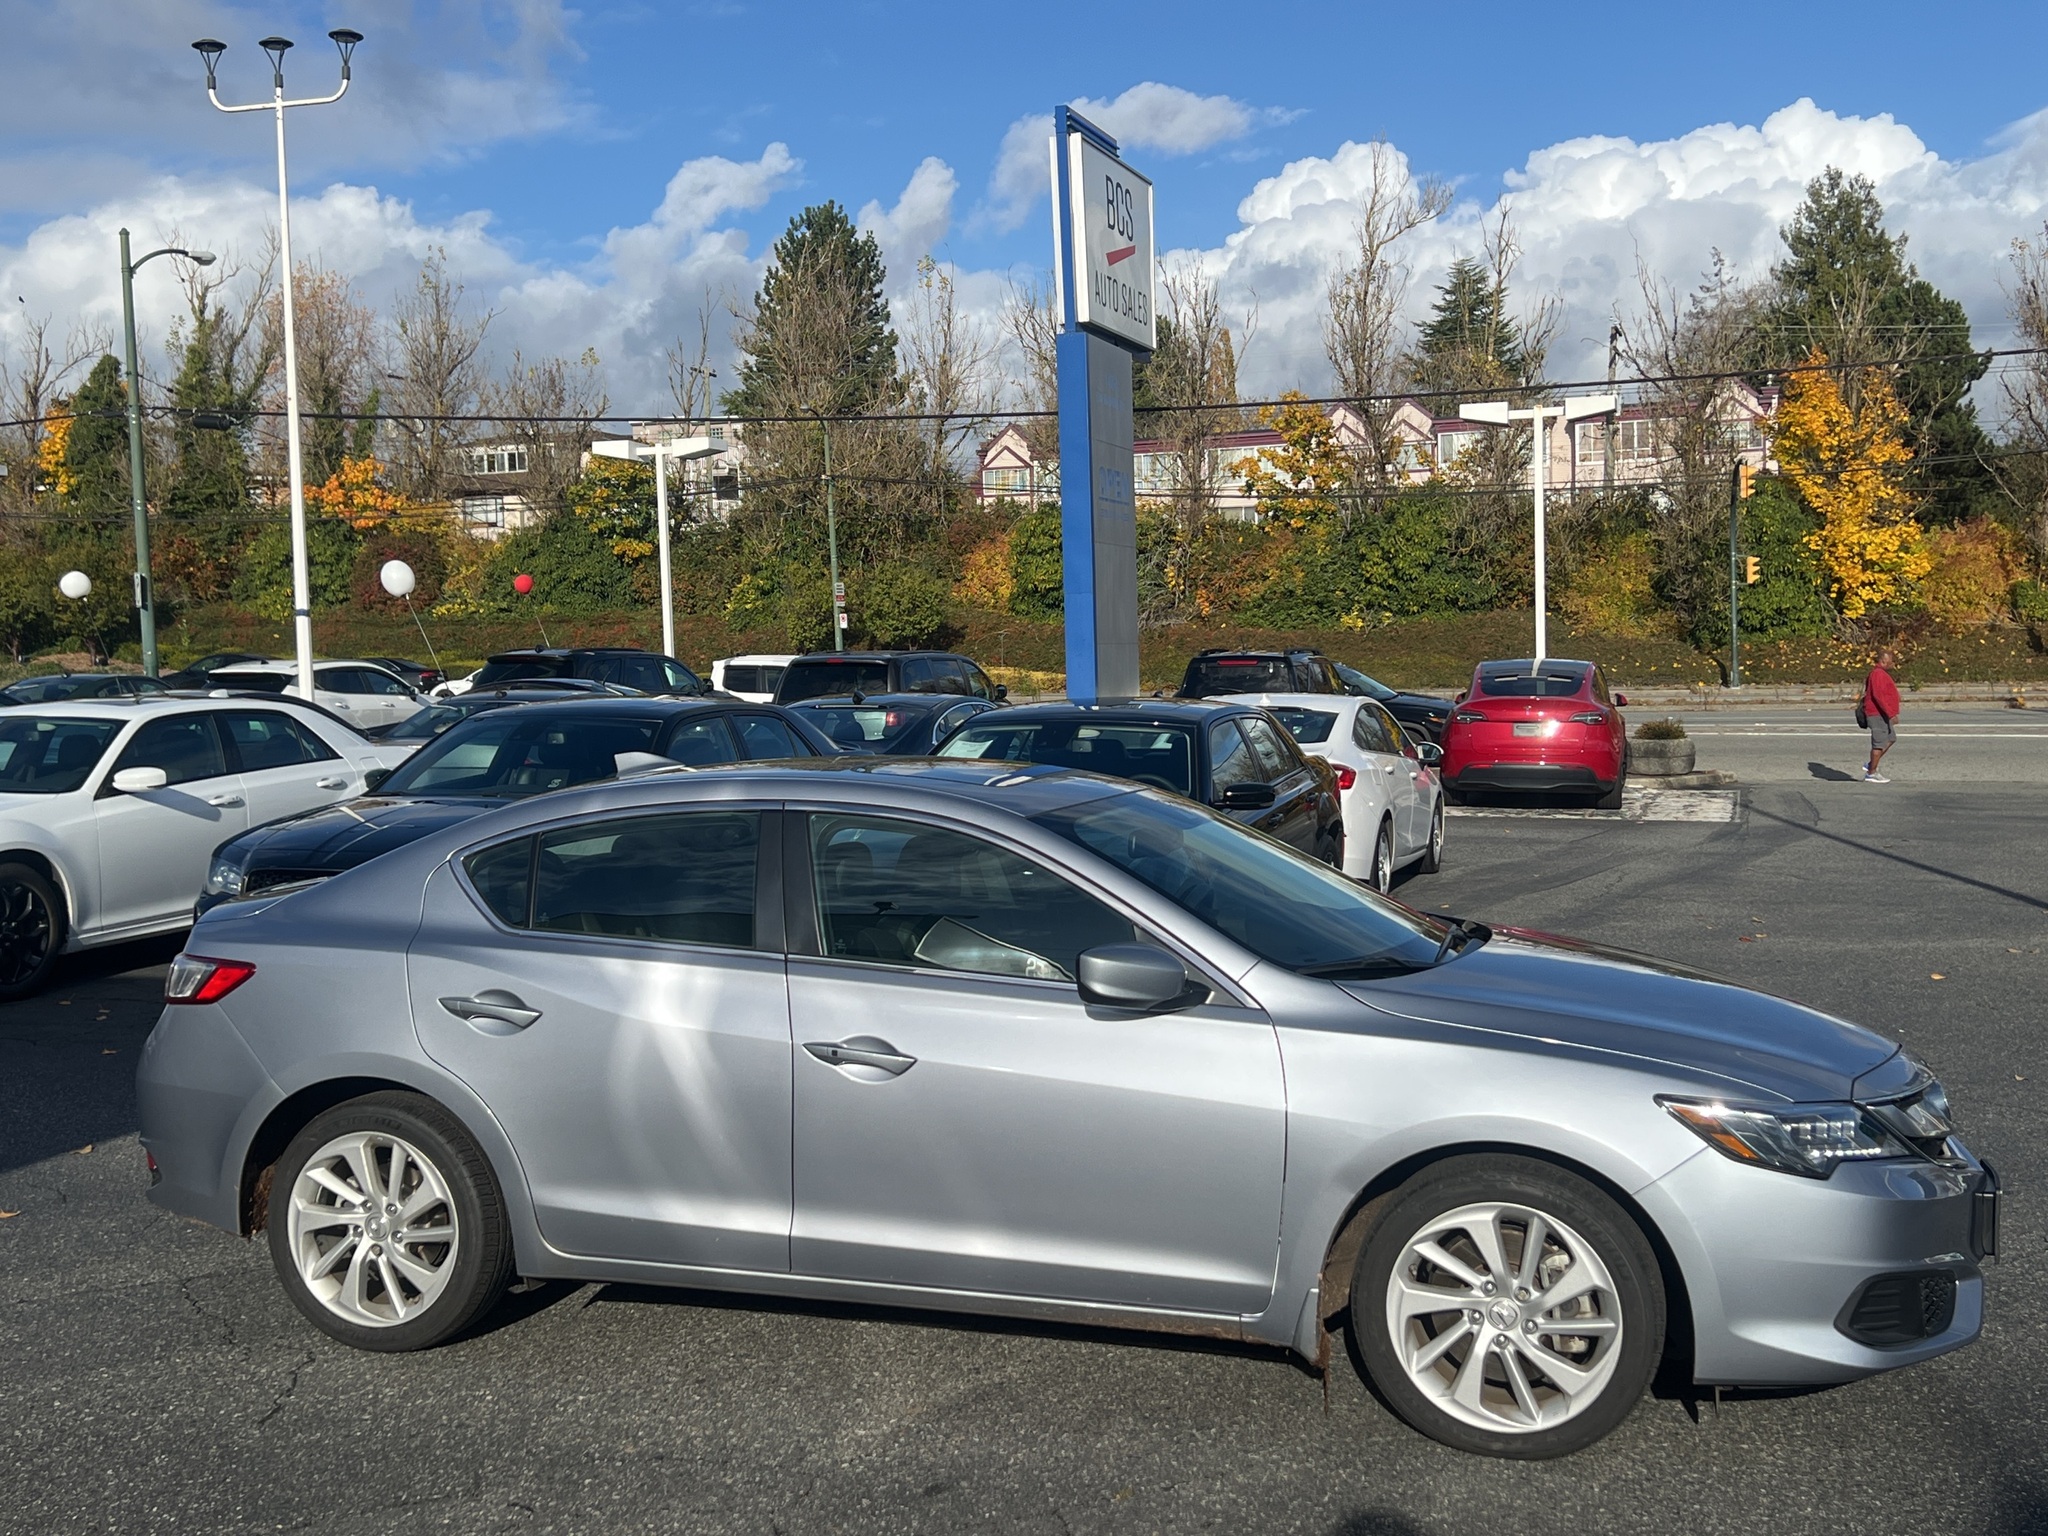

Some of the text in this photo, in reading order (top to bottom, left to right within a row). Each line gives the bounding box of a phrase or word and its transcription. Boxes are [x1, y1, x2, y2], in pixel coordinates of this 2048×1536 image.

[1105, 174, 1134, 242] BCS
[1094, 270, 1148, 326] AUTO SALES
